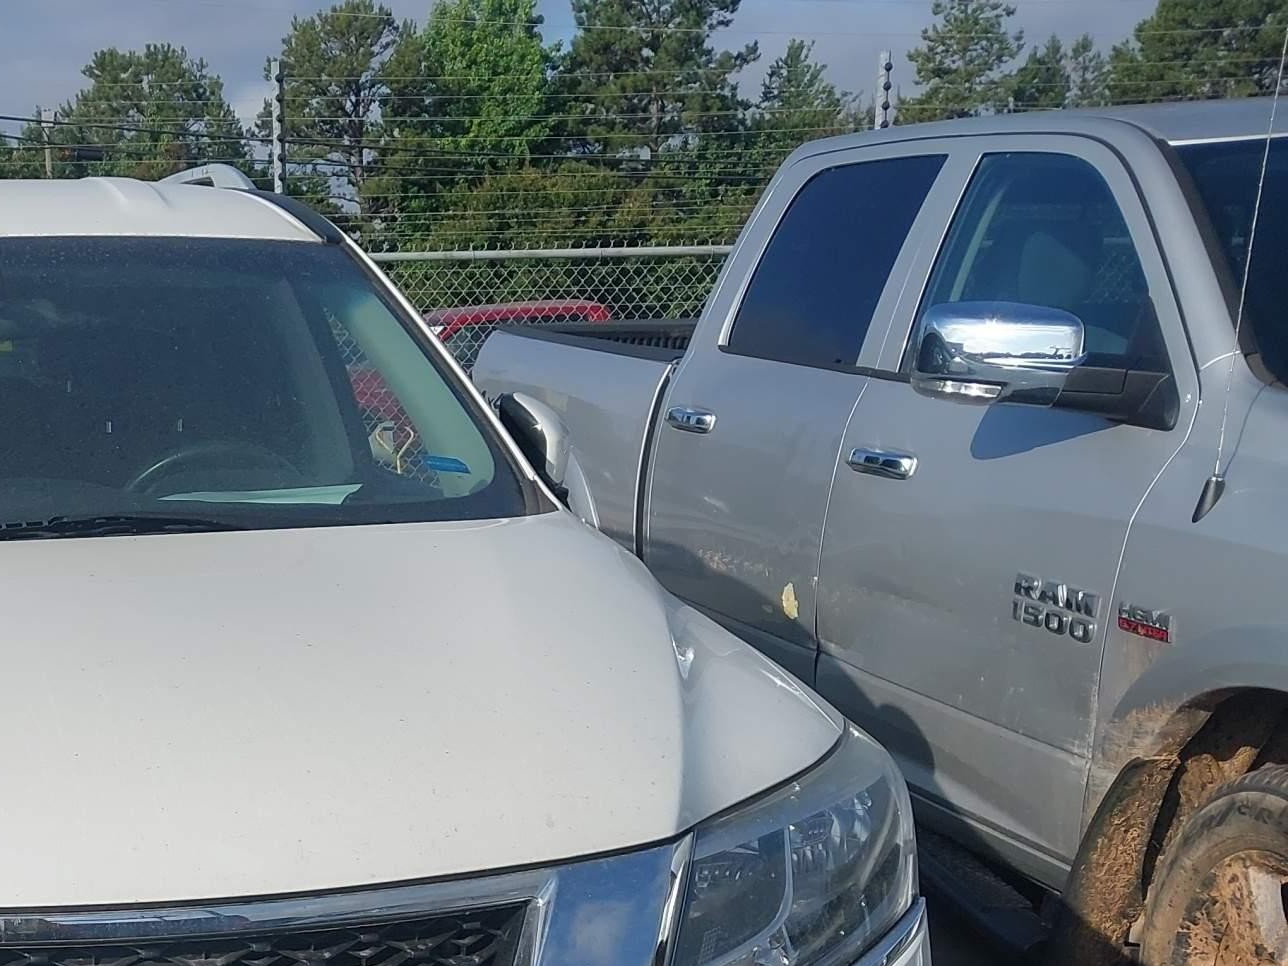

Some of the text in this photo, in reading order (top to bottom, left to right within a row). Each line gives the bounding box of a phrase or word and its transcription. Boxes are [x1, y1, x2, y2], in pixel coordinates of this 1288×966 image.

[1014, 572, 1101, 618] RAM
[1118, 601, 1173, 631] HEMI
[1013, 600, 1097, 643] 1500
